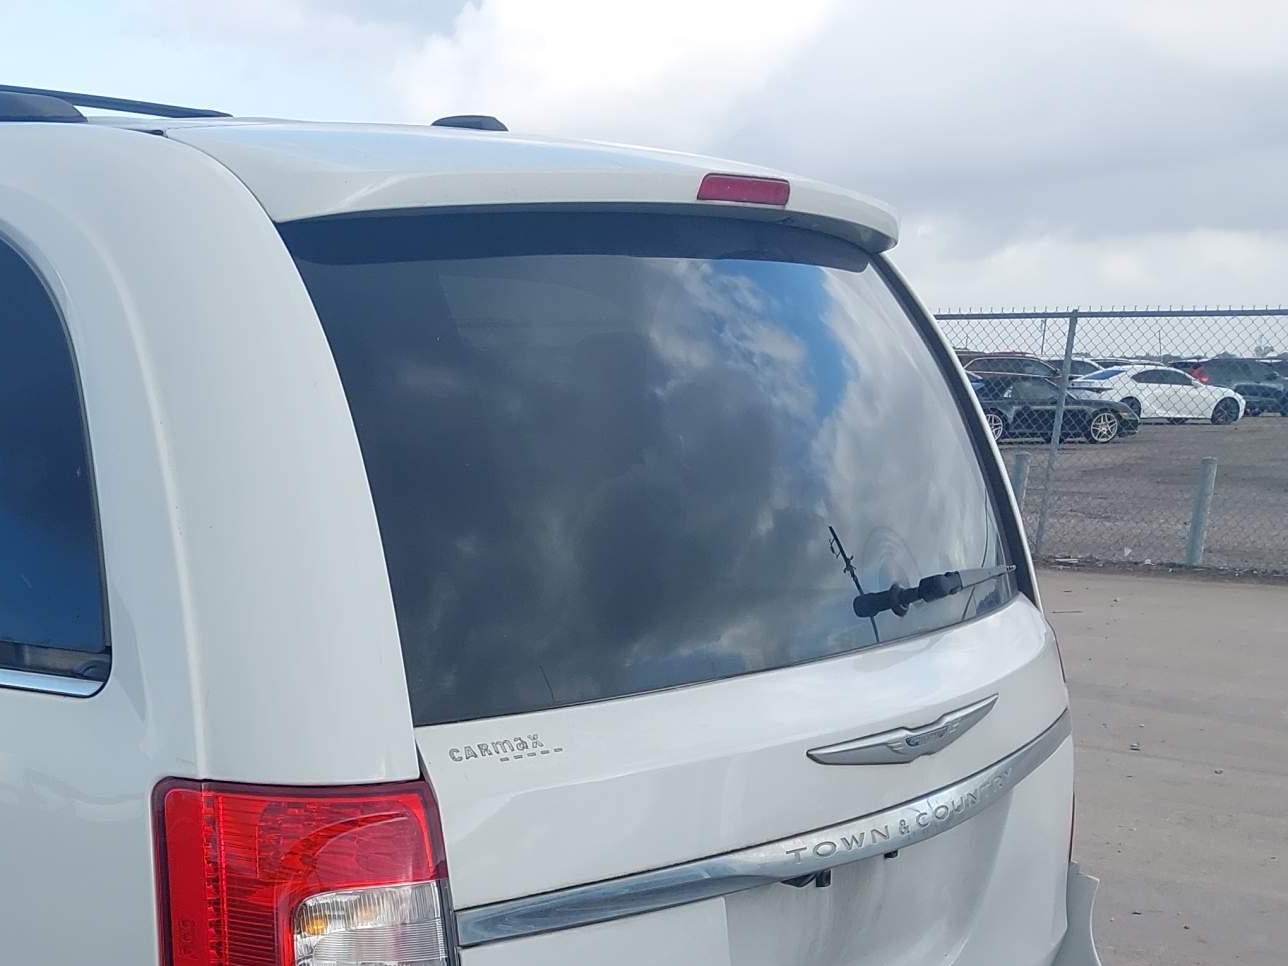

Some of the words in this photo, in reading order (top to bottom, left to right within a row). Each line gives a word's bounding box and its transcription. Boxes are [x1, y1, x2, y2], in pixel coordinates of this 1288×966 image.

[785, 825, 891, 865] TOWN
[898, 818, 911, 836] &
[915, 767, 1014, 829] COUNTRY
